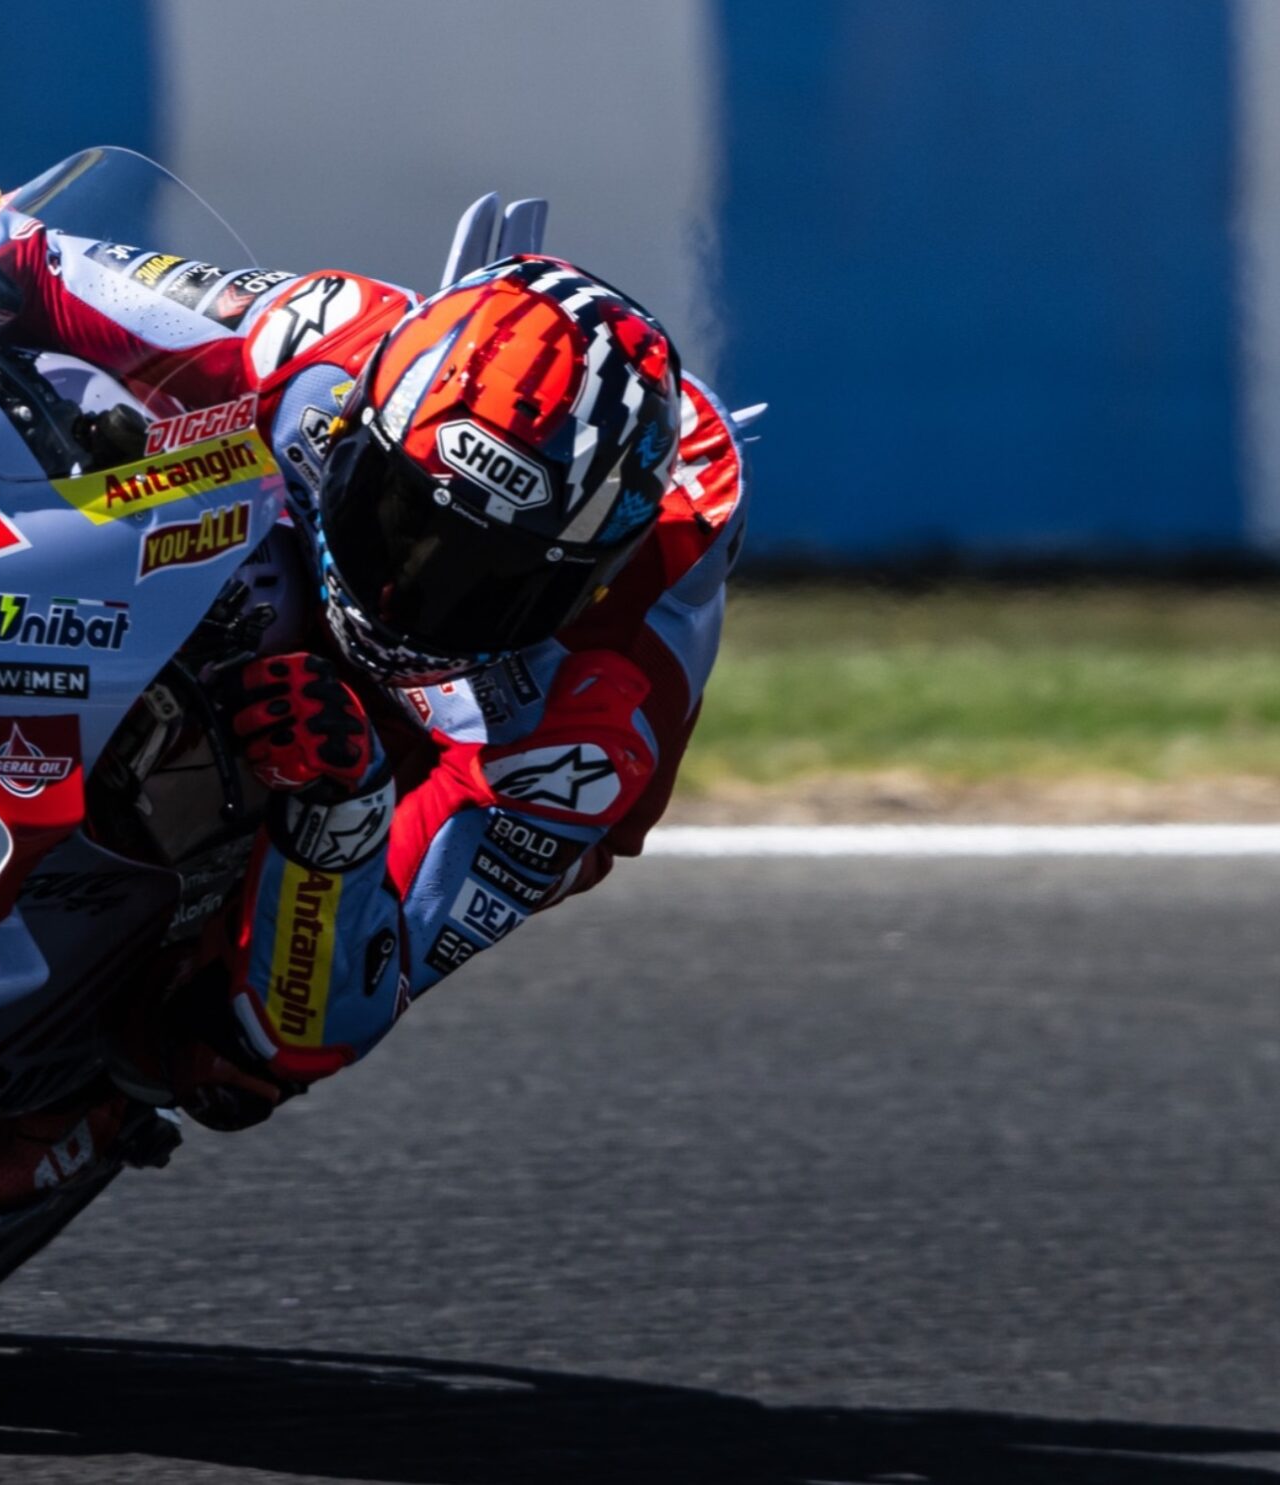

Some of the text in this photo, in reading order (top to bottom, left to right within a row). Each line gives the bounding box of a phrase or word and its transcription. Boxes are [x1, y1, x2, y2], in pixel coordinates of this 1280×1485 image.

[146, 399, 256, 455] DIGGIA
[106, 440, 258, 508] Antangin
[450, 431, 541, 500] SHOEI
[148, 505, 244, 567] YOU-ALL
[32, 670, 86, 693] MEN
[38, 761, 62, 774] OIL
[494, 816, 558, 858] BOLD
[277, 869, 334, 1037] Antangin
